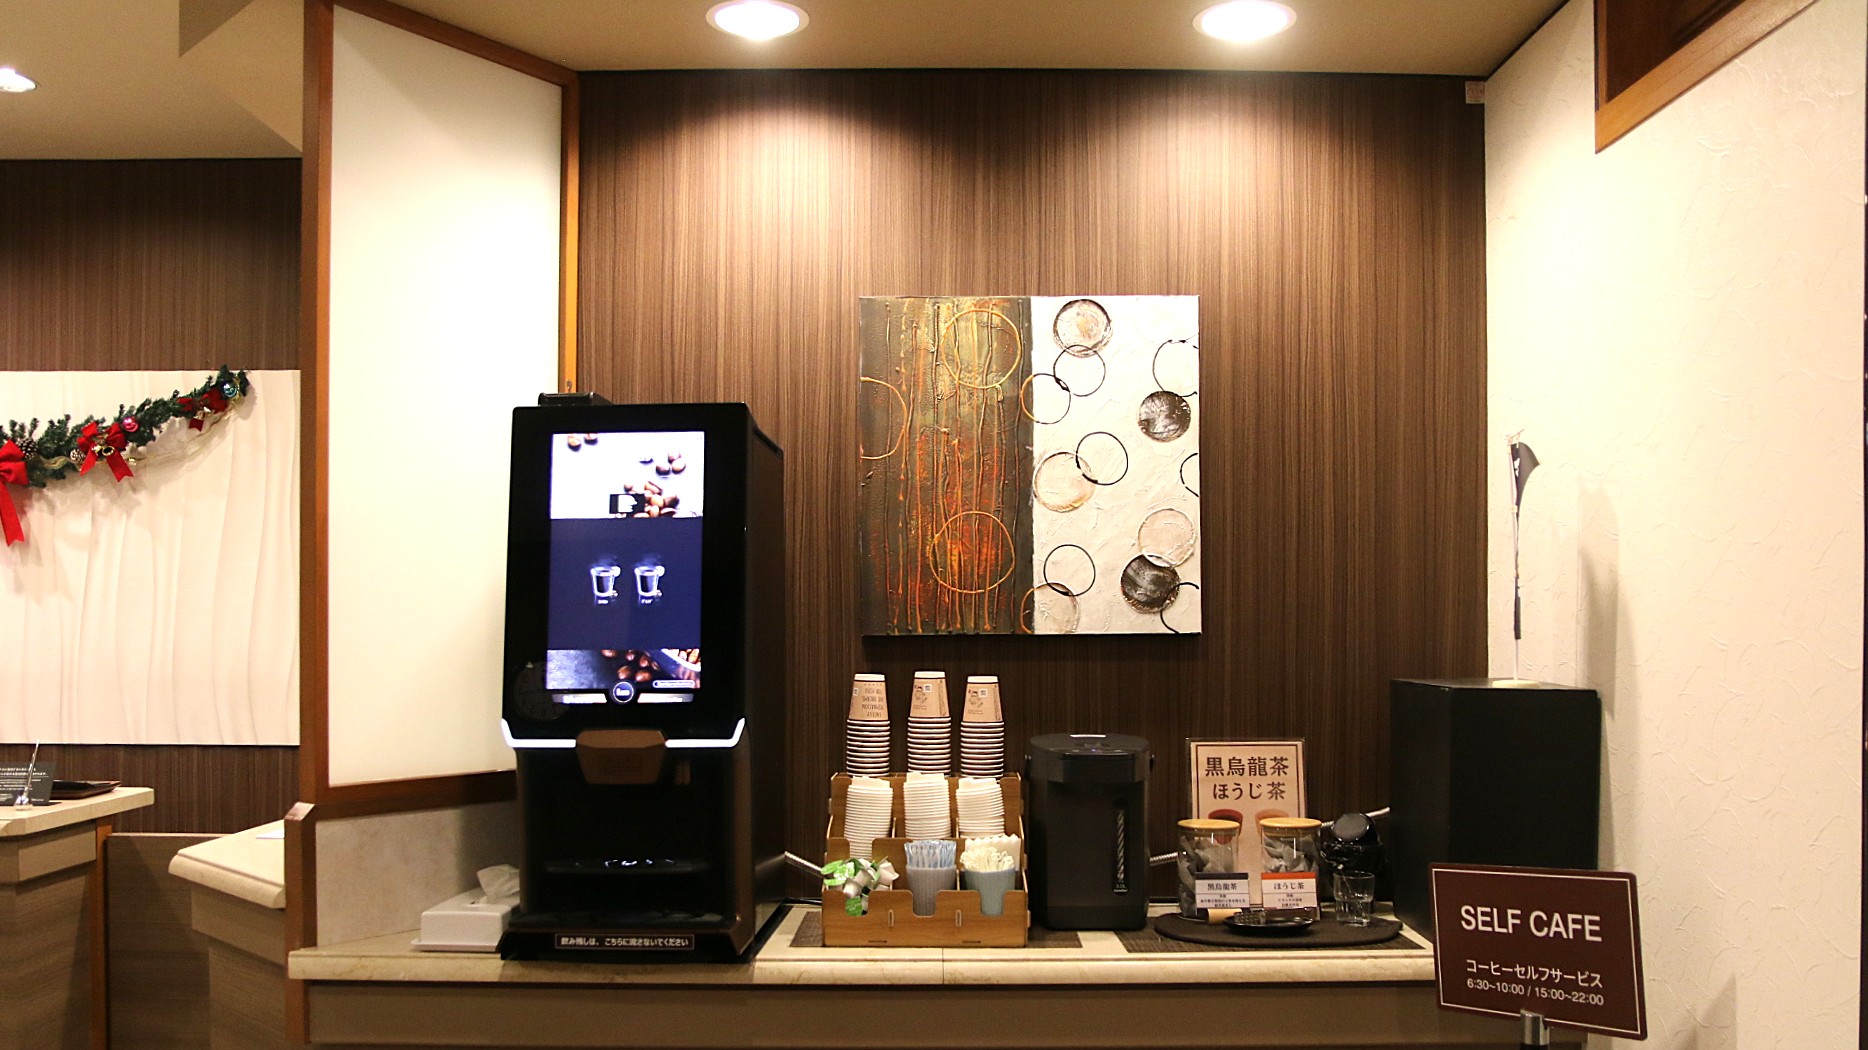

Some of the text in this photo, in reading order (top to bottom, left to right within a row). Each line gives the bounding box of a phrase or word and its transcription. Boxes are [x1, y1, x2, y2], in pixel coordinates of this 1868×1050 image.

[1205, 756, 1289, 777] 黒烏龍茶
[1213, 781, 1286, 801] ほうじ茶
[1273, 882, 1305, 890] ほうじ茶
[1460, 905, 1602, 942] SELF CAFE
[1466, 959, 1603, 989] コーヒーセルフサービス
